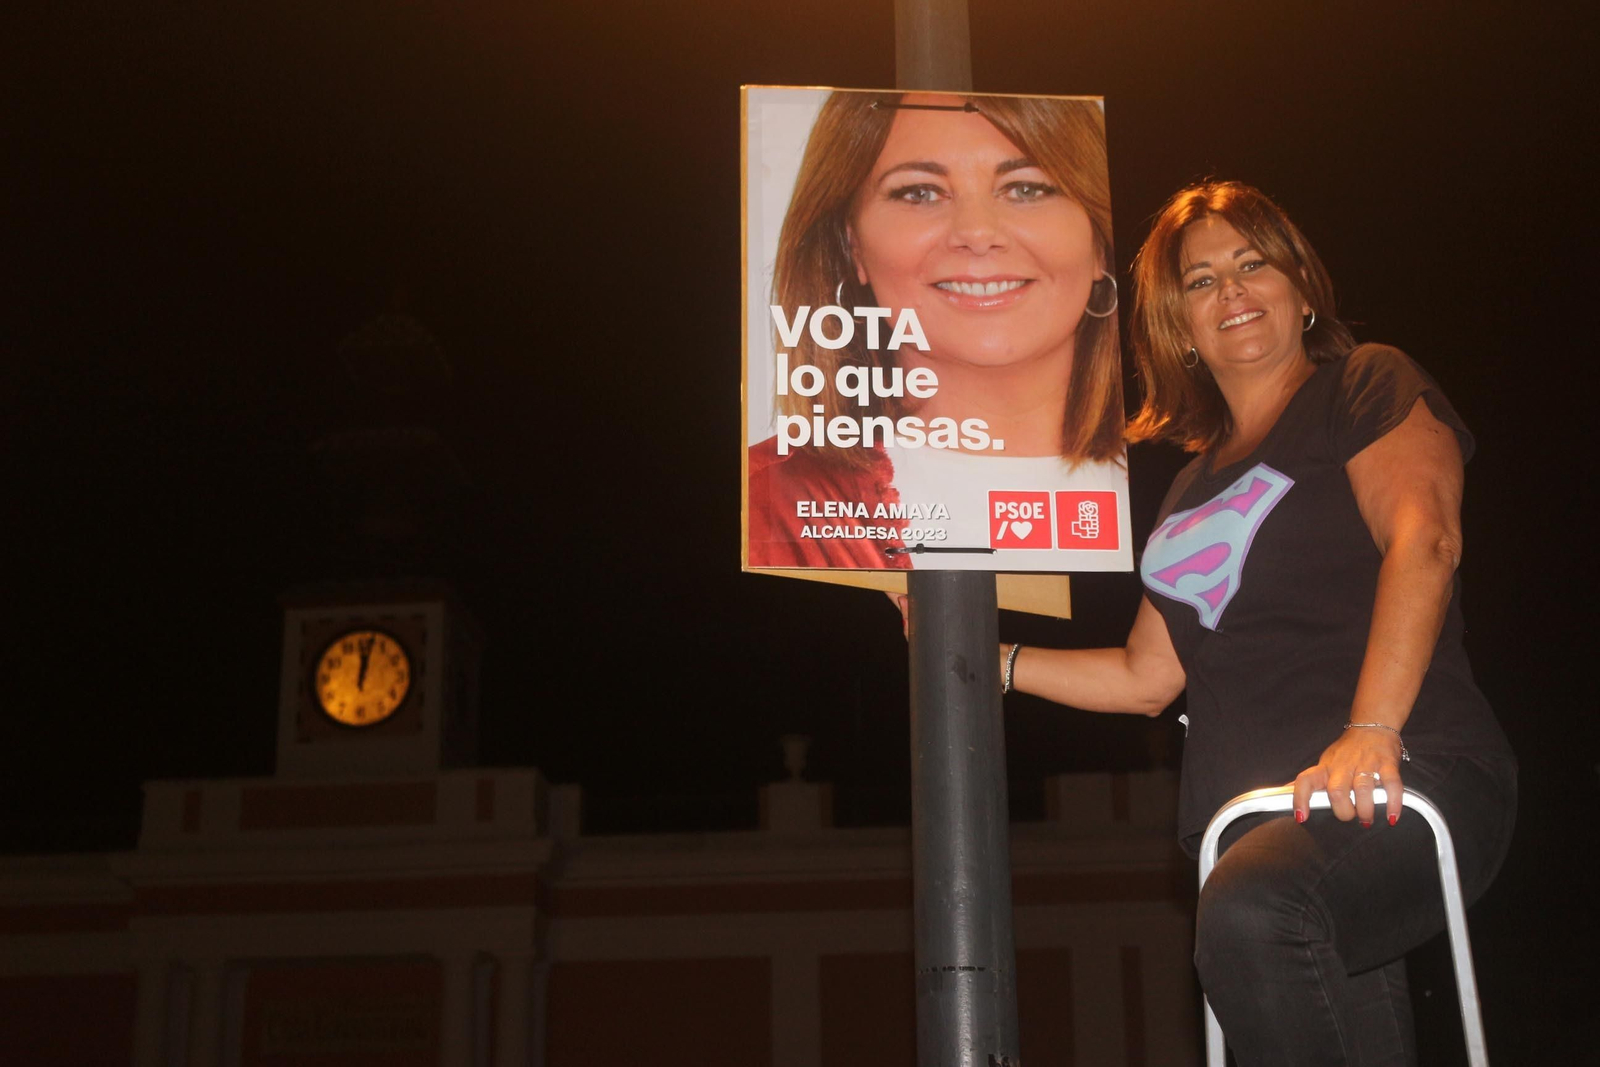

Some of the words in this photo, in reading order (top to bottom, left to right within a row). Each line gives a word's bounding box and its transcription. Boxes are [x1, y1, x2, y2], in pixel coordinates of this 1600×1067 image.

[770, 305, 931, 351] VOTA
[776, 353, 826, 398] lo
[835, 364, 939, 407] que
[776, 404, 1006, 456] piensas.
[796, 501, 869, 519] ELENA
[872, 504, 951, 521] AMAYA
[994, 501, 1045, 520] PSOE
[800, 525, 899, 541] ALCALDESA
[901, 527, 948, 541] 2023
